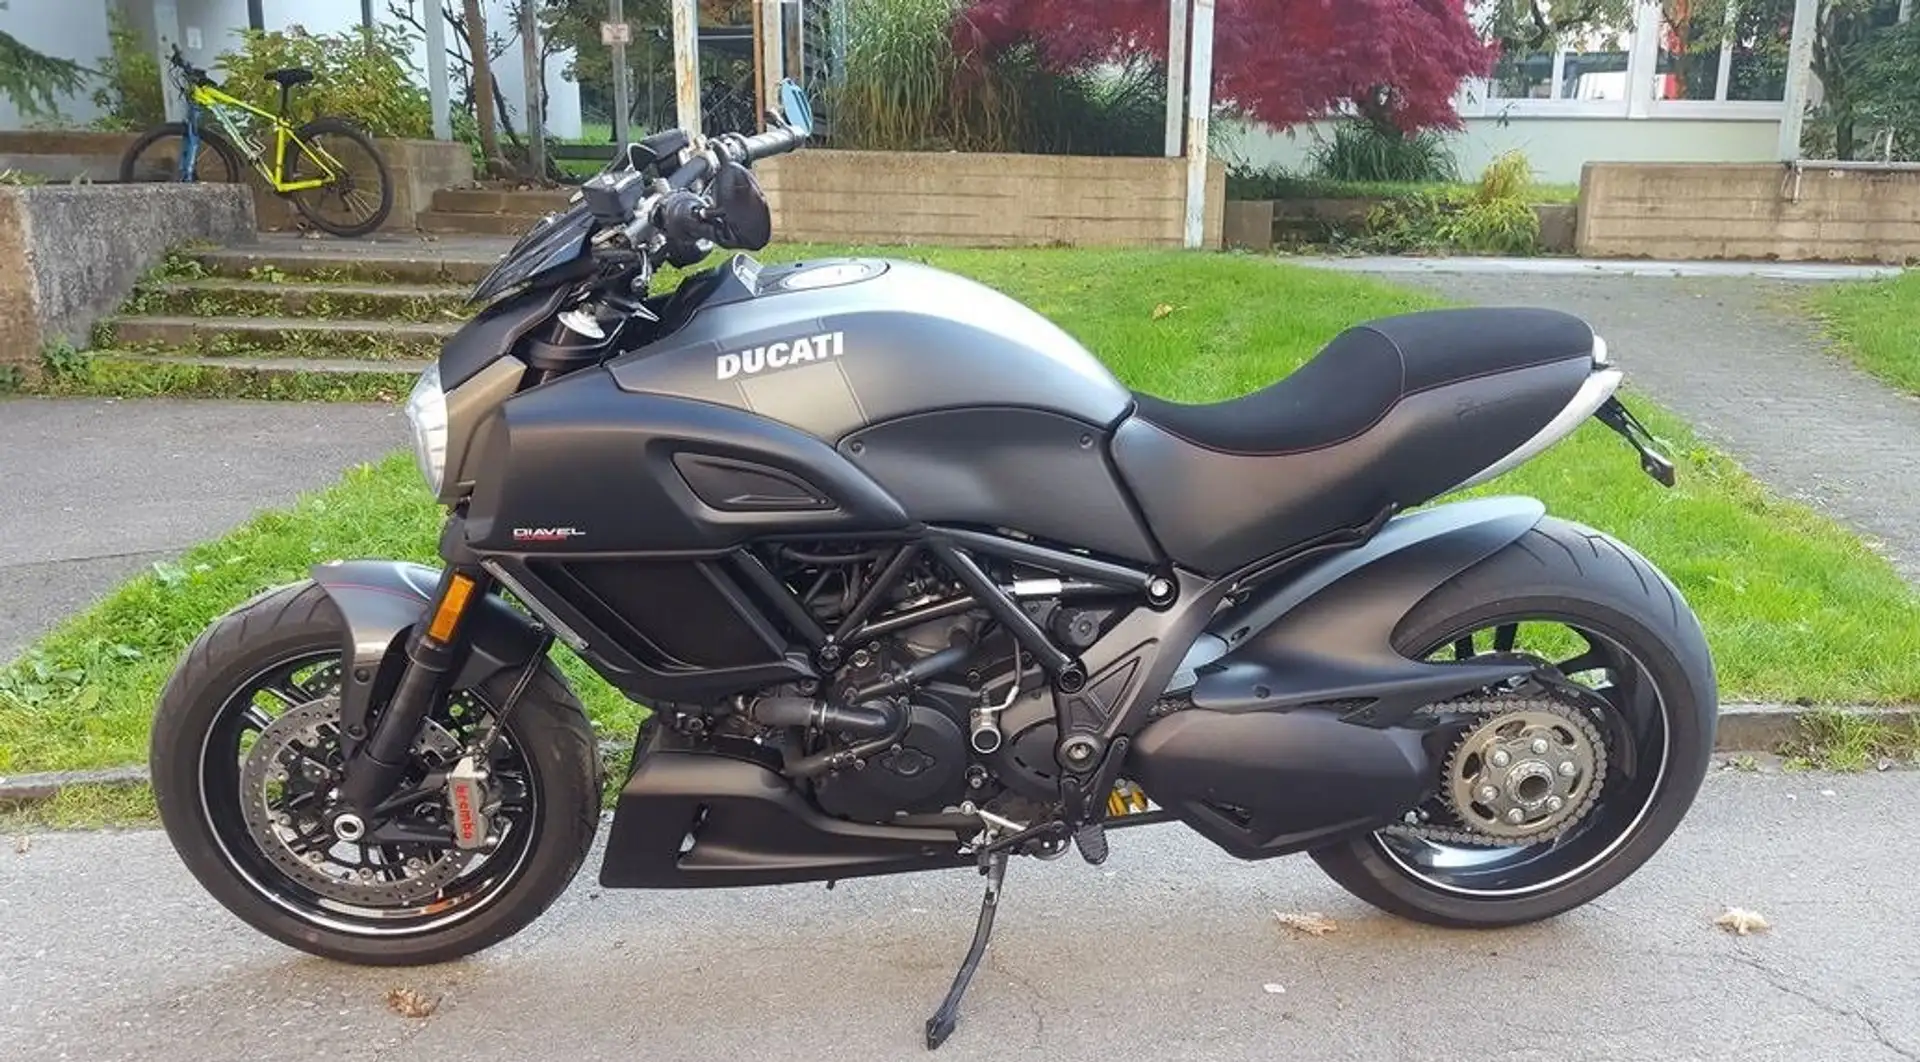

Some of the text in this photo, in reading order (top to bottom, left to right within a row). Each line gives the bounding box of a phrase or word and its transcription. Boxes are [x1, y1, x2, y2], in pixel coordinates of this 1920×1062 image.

[717, 331, 844, 380] DUCATI
[513, 528, 586, 536] DIAVEL
[456, 783, 475, 840] brembo
